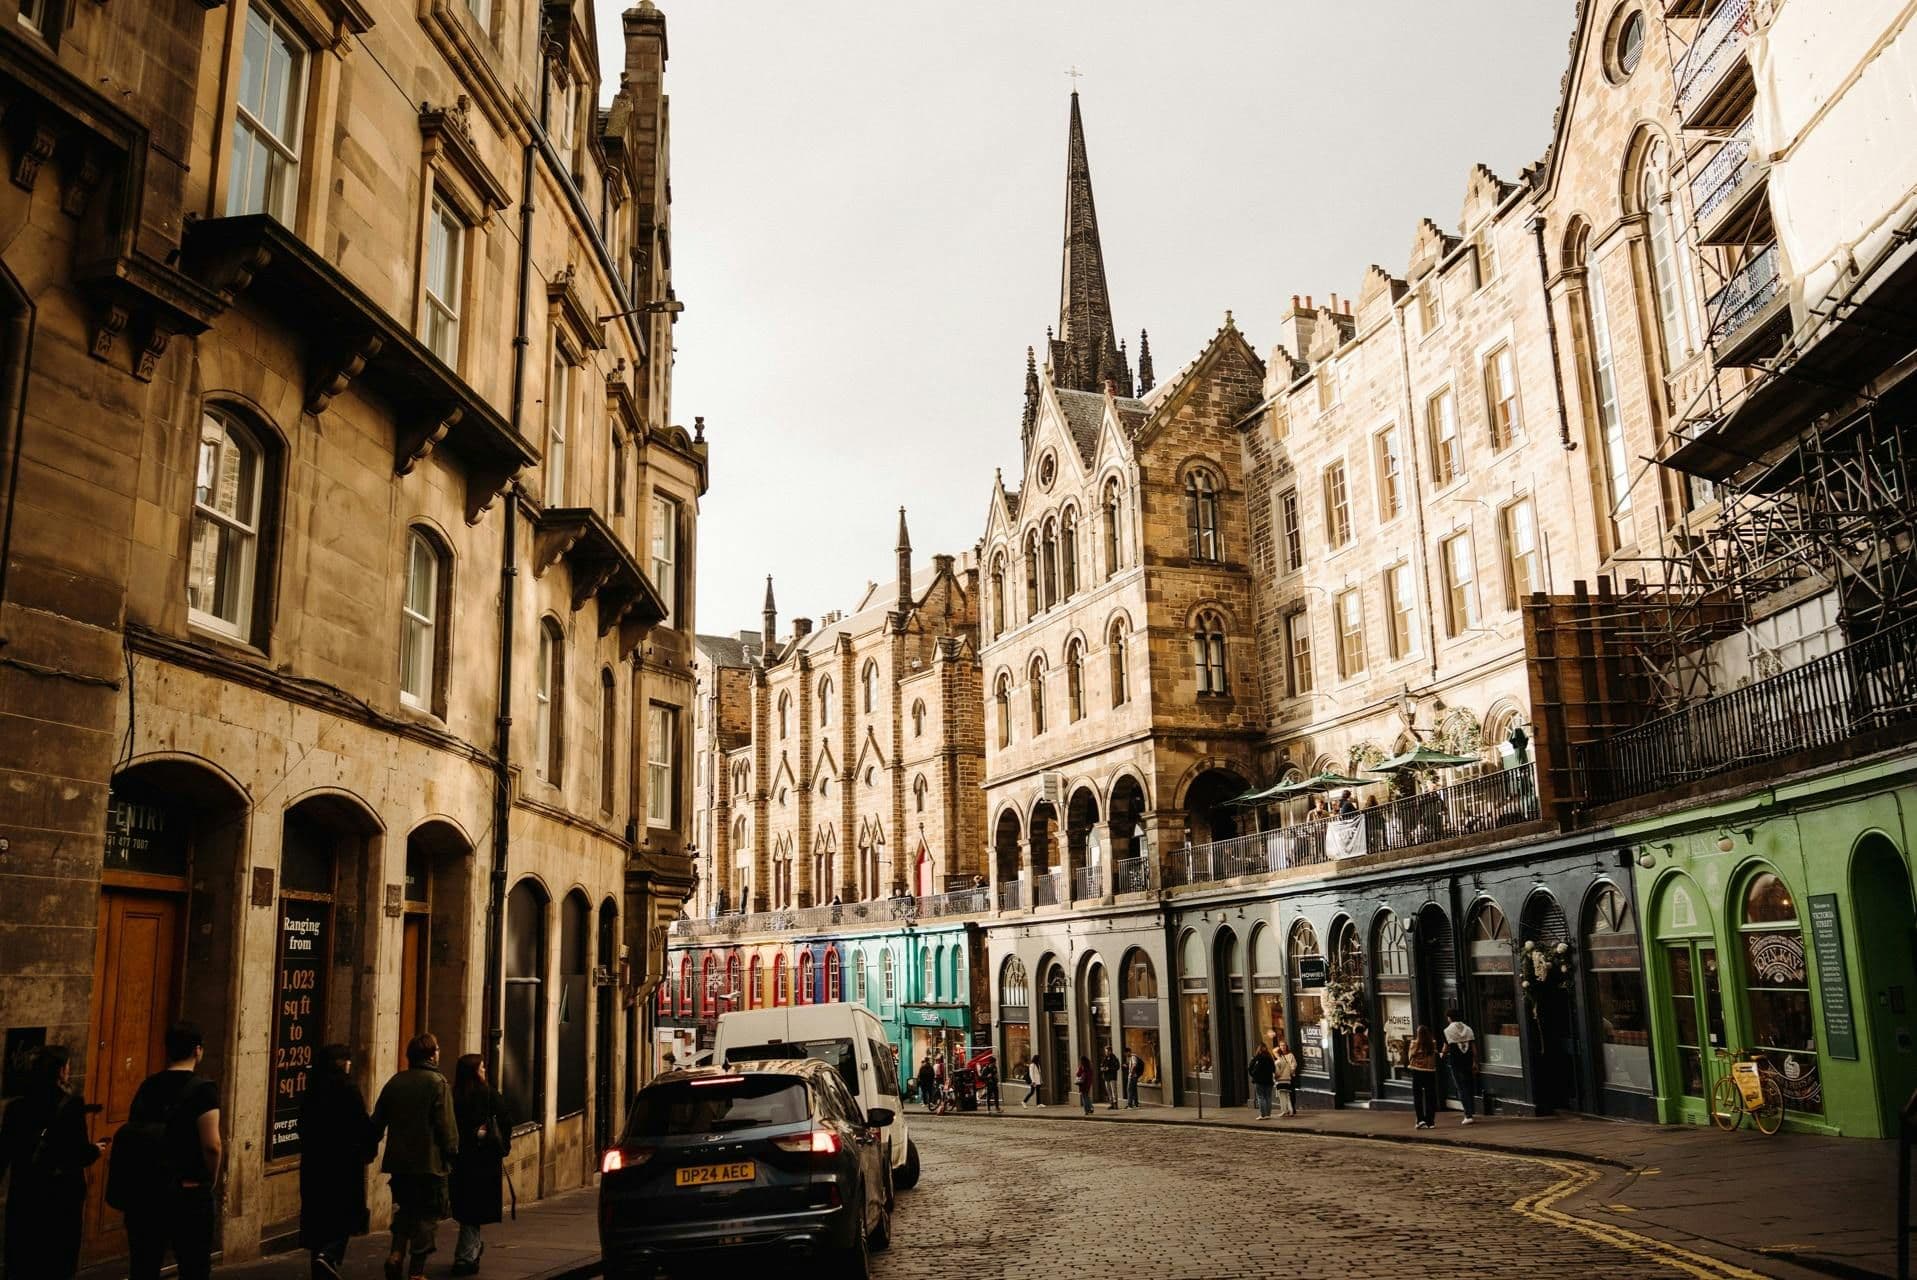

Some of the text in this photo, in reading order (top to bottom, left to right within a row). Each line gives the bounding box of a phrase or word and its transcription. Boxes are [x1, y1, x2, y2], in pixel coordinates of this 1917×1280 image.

[284, 917, 320, 936] Ranging
[289, 936, 312, 950] from
[281, 969, 315, 992] 1,023
[1301, 971, 1325, 979] HOWIES
[284, 995, 311, 1020] sq ft
[1388, 1016, 1411, 1025] HOWIES
[290, 1023, 303, 1041] to
[278, 1046, 311, 1071] 2,239
[280, 1072, 307, 1099] sq ft
[274, 1121, 288, 1130] over
[682, 1164, 749, 1184] DP24 AEC
